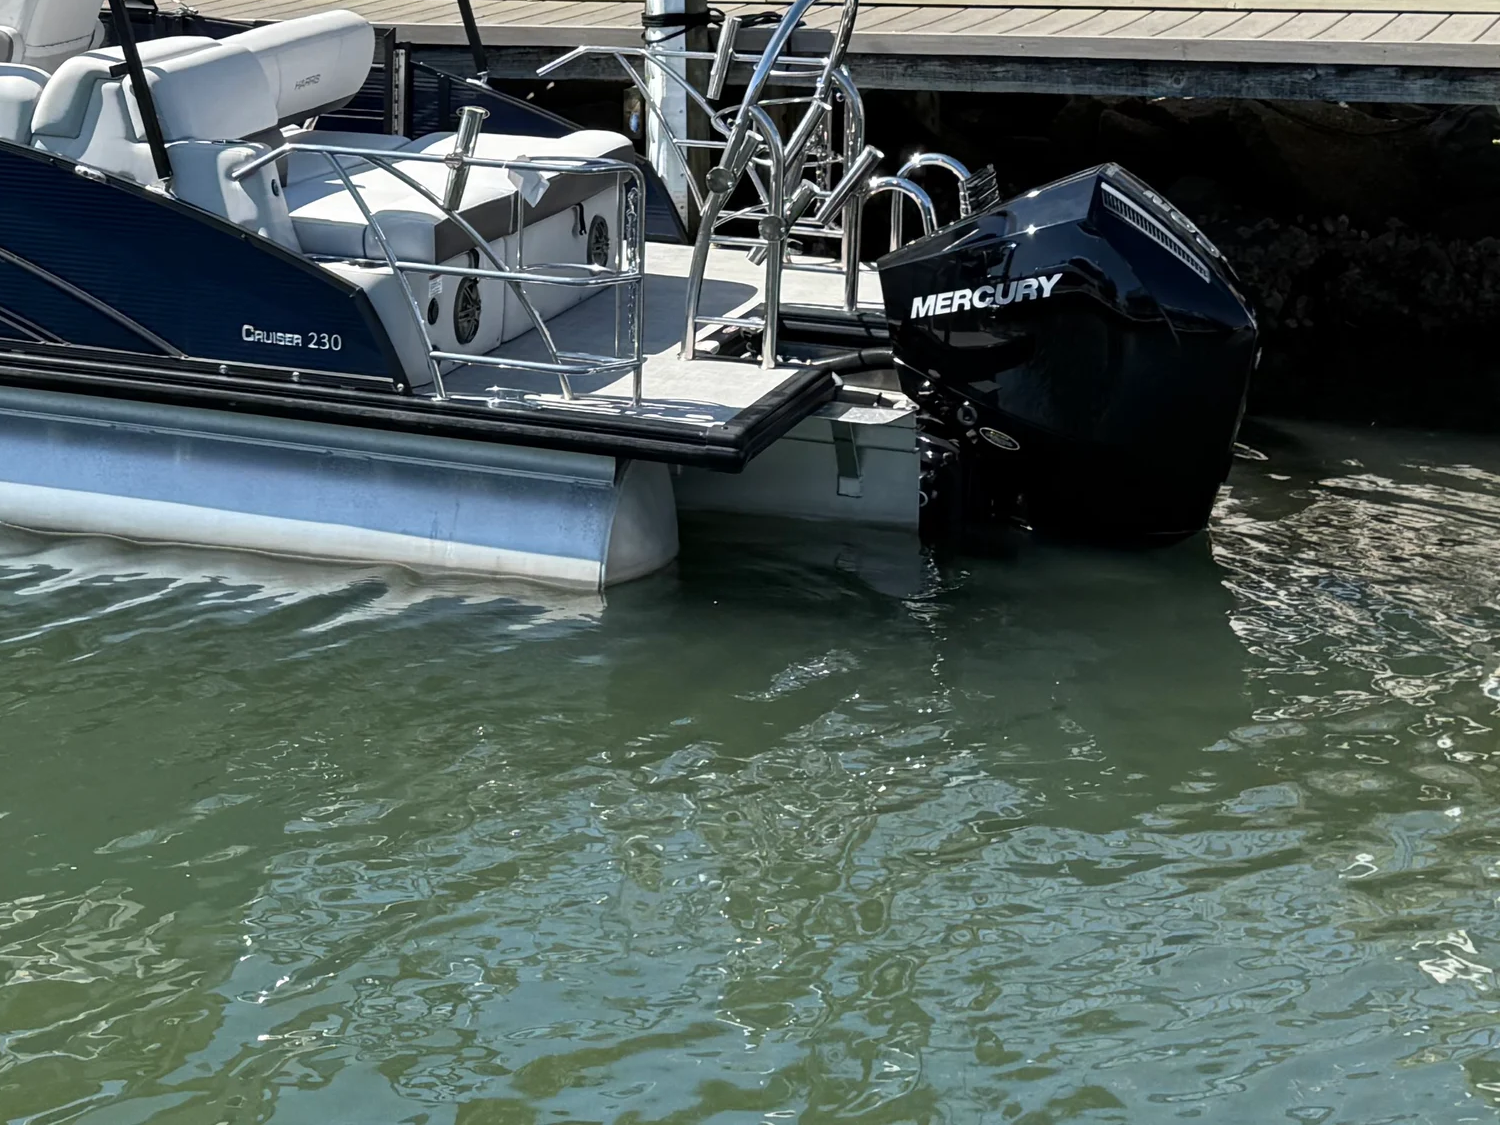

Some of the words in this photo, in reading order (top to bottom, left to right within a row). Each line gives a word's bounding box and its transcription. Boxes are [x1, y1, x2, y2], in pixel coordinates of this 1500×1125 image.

[294, 73, 321, 90] HARRIS
[910, 273, 1063, 319] MERCURY
[307, 332, 342, 351] 230
